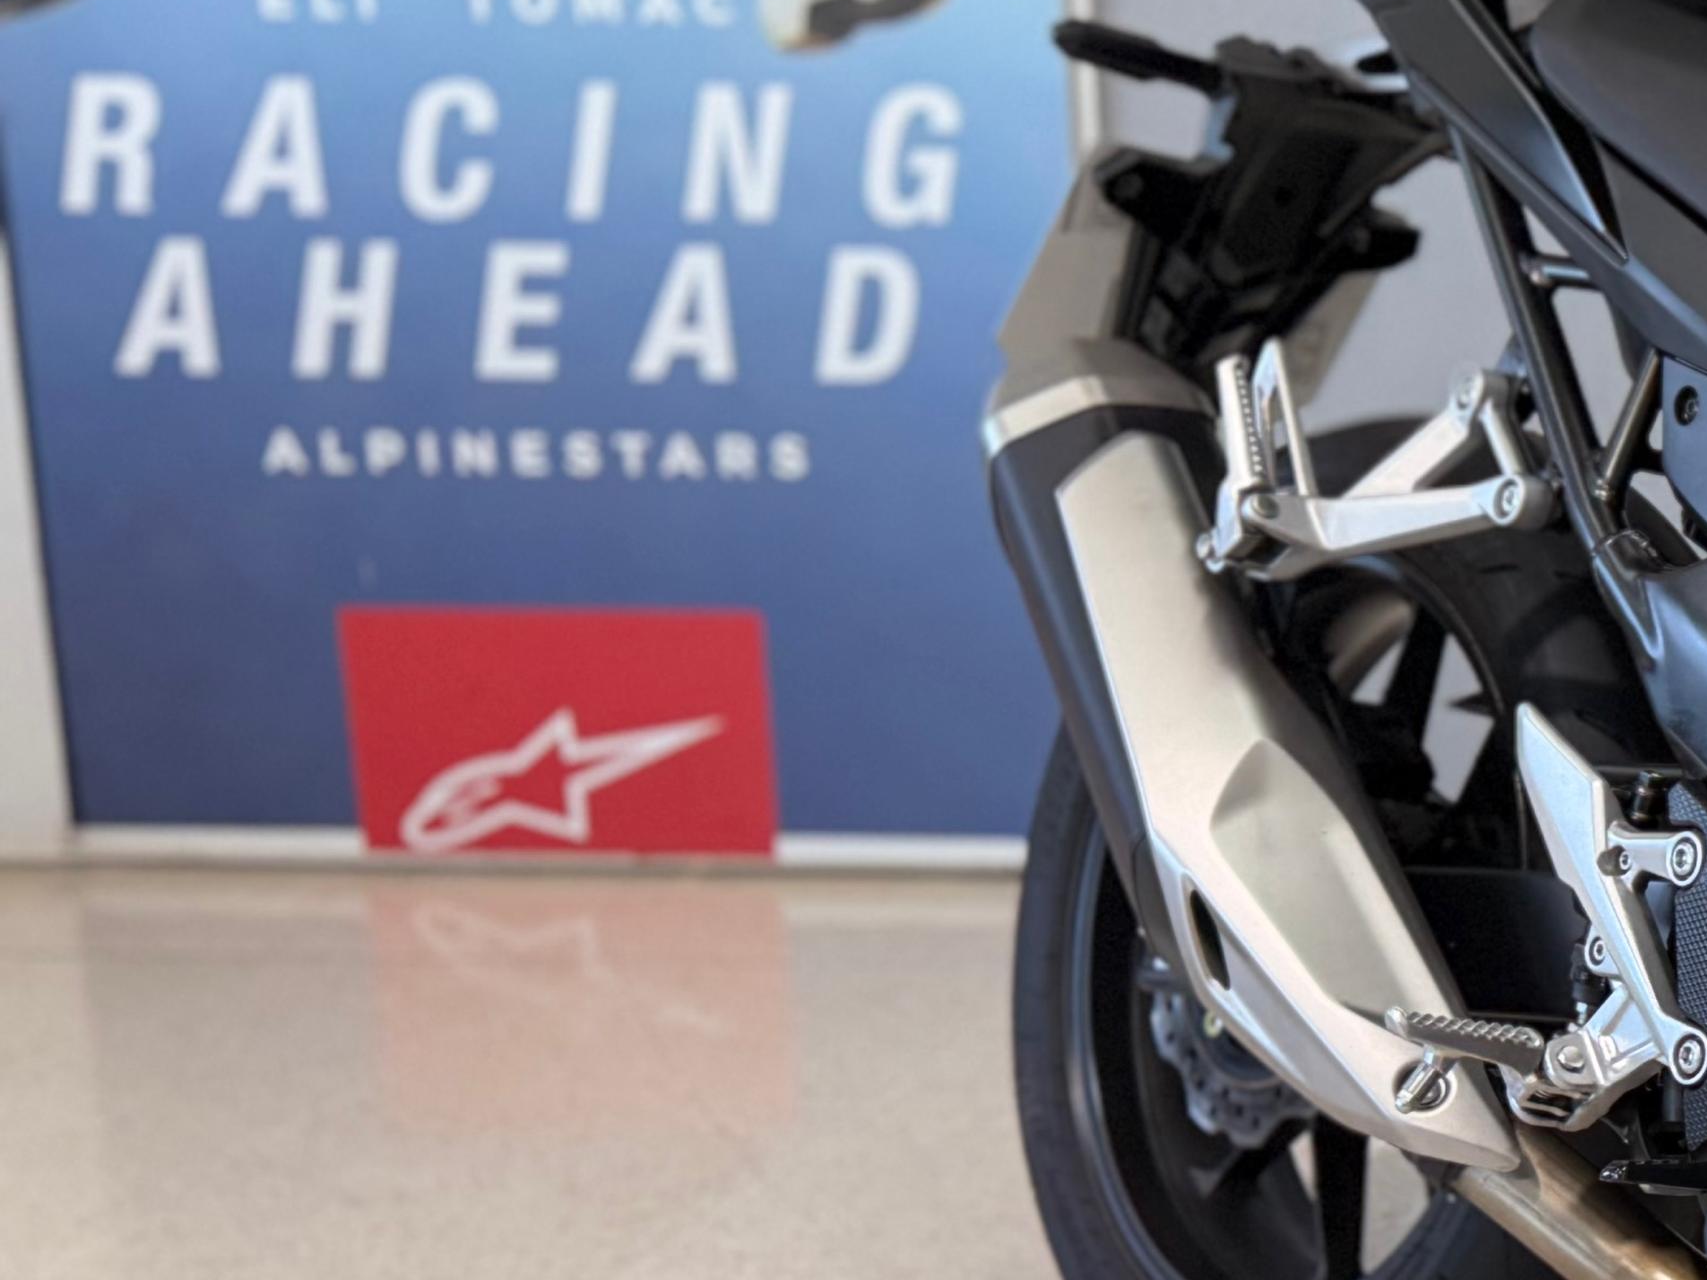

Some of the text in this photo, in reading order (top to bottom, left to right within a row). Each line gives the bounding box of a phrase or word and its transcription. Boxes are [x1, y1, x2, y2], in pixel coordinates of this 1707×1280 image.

[60, 73, 964, 228] RACING
[114, 236, 921, 386] AHEAD
[262, 427, 810, 481] ALPINESTARS
